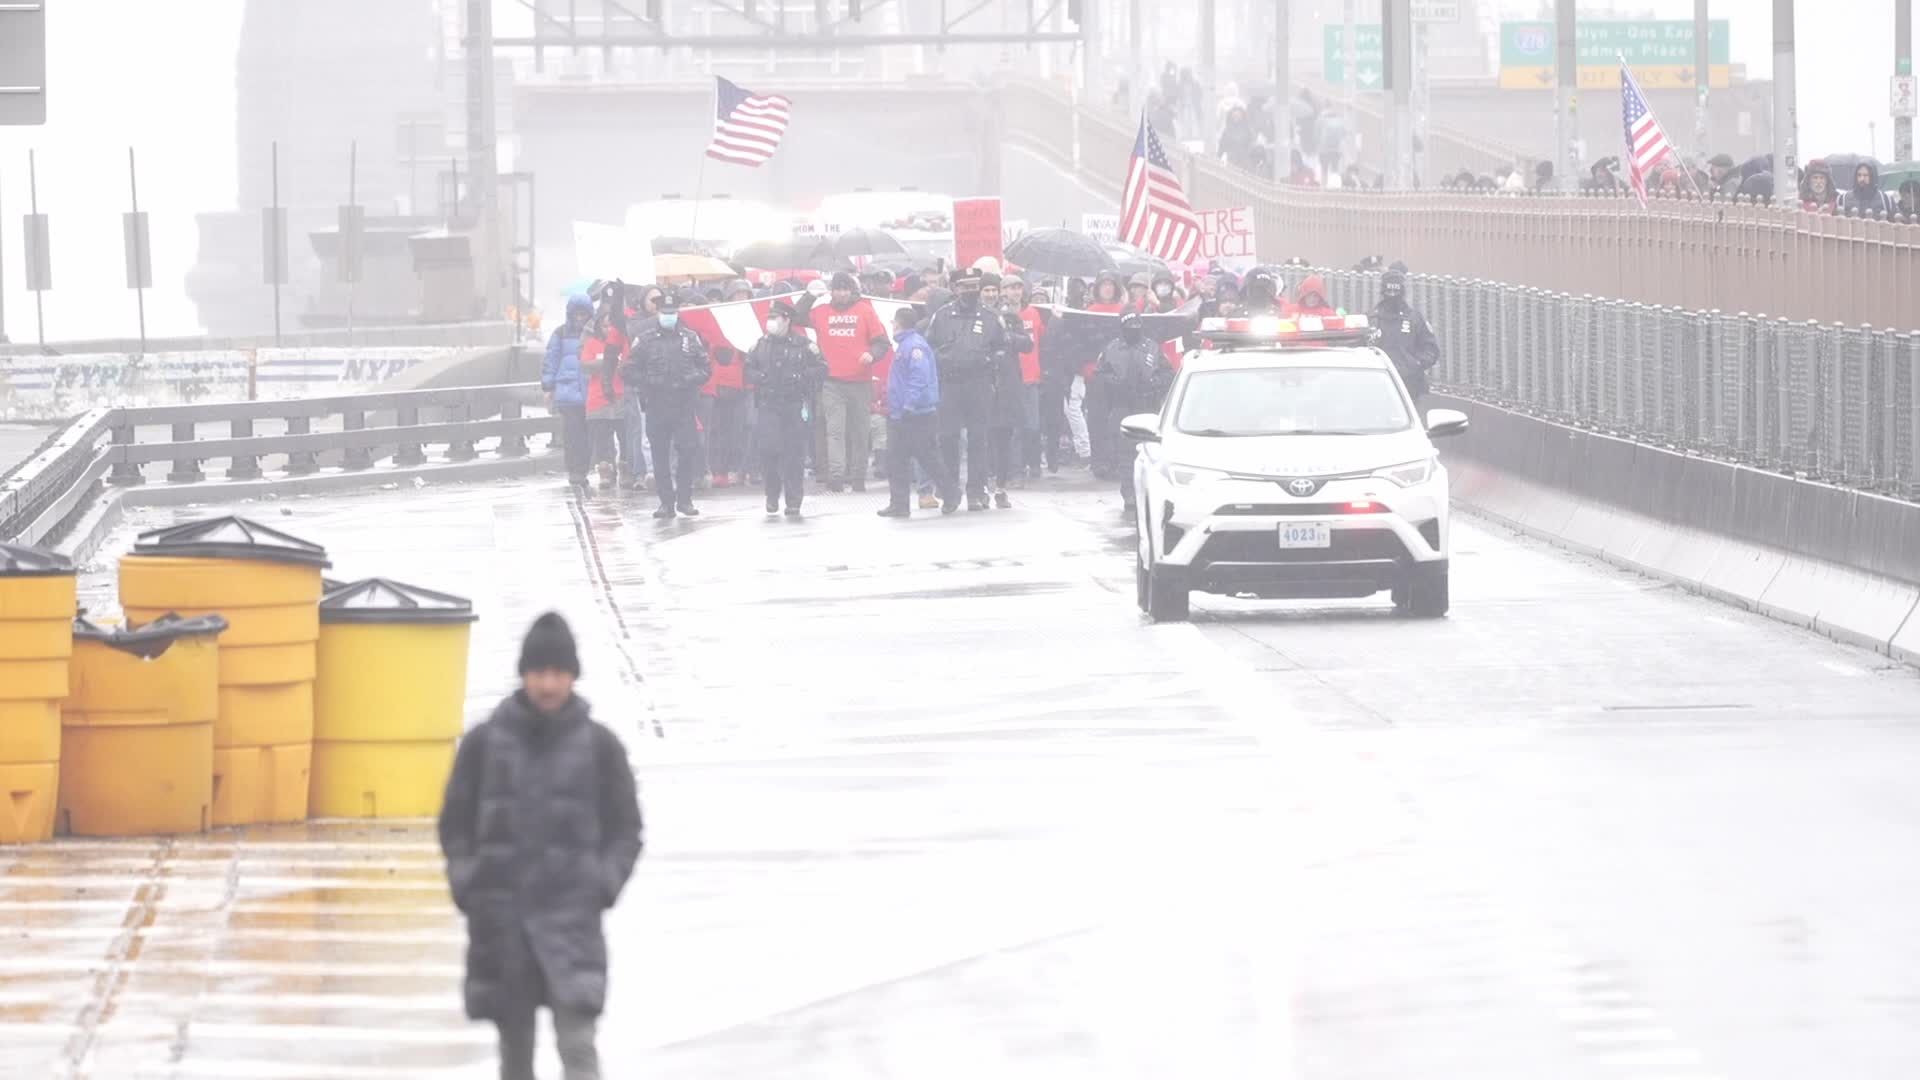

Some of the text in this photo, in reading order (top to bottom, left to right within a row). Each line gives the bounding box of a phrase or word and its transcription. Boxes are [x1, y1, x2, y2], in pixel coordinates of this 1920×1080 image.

[825, 223, 841, 233] THE
[1202, 232, 1254, 258] UCI
[828, 328, 856, 337] CHOICE
[1282, 527, 1316, 542] 4023
